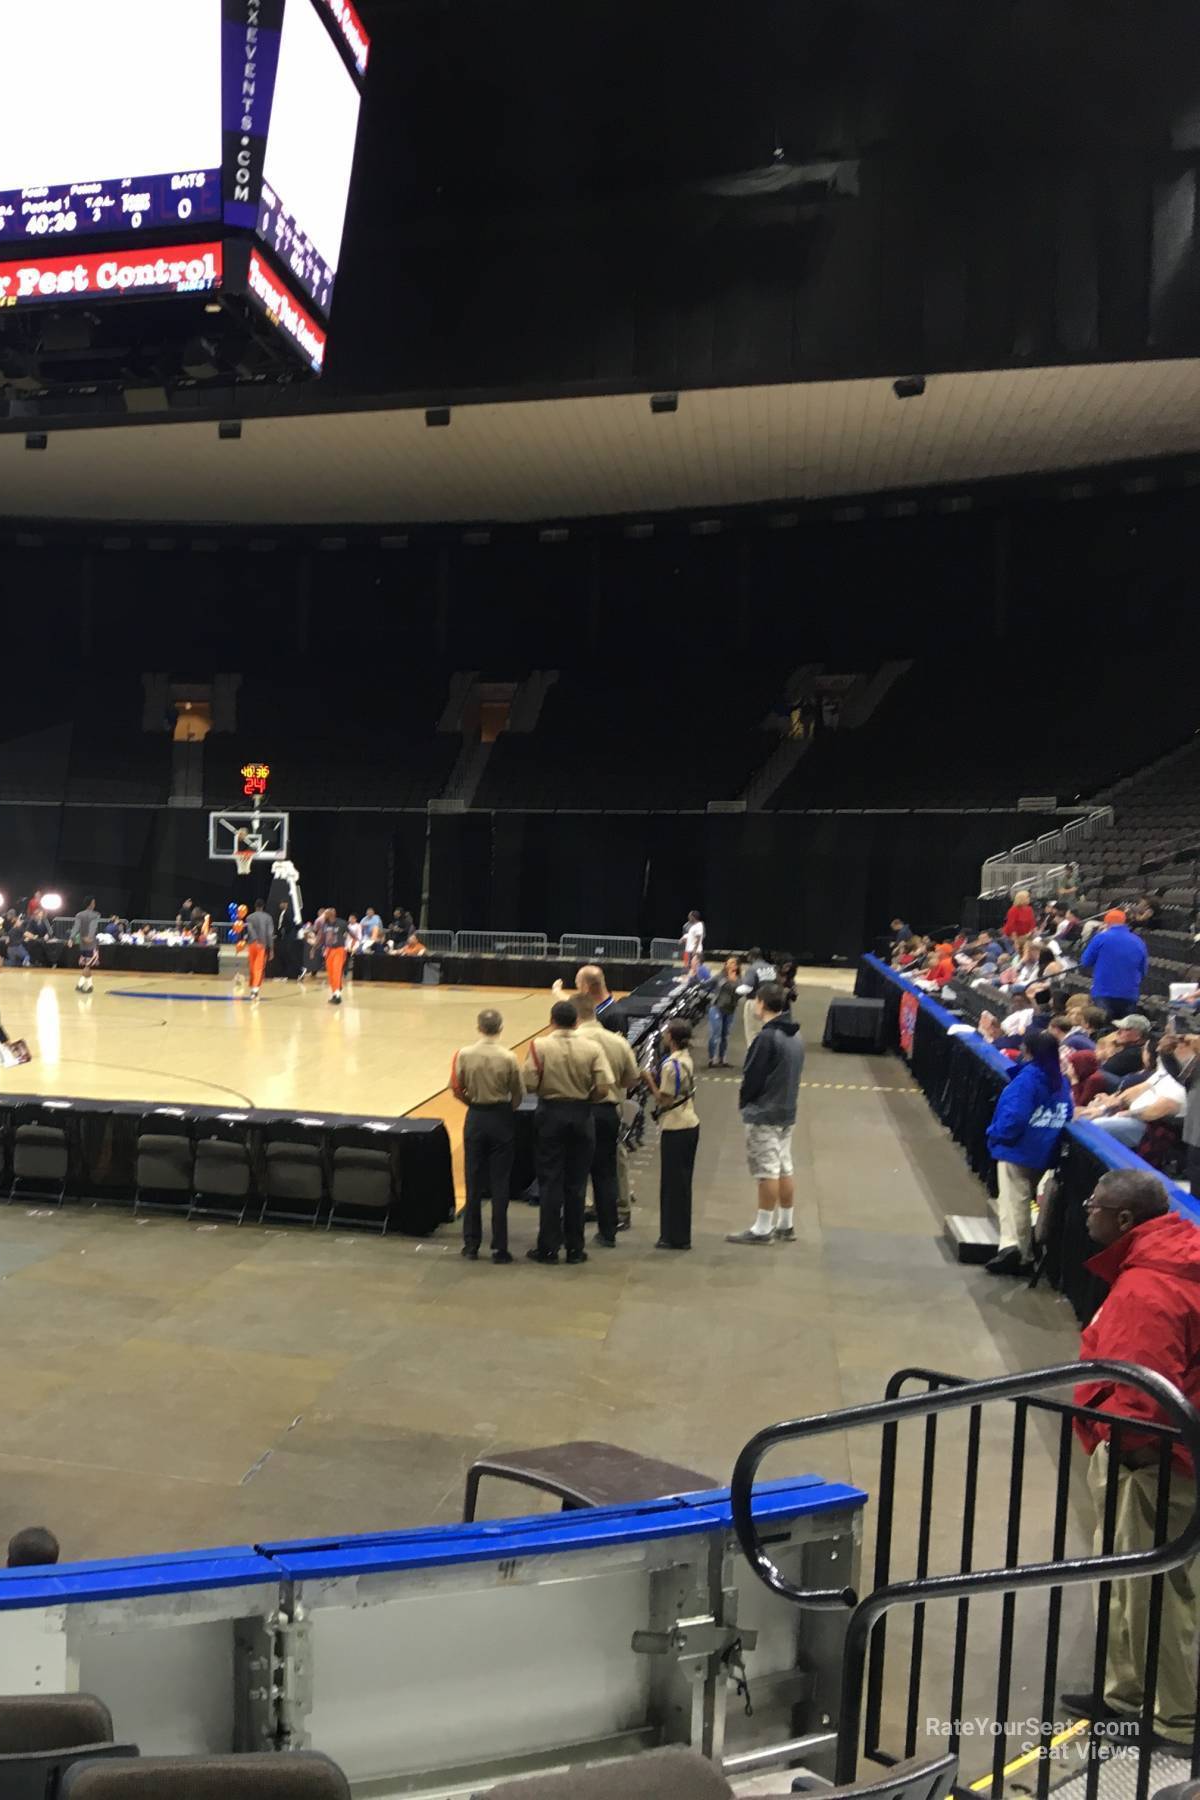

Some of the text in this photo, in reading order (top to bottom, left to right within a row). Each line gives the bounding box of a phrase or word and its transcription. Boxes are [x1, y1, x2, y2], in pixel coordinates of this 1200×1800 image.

[177, 198, 192, 219] 0
[16, 265, 89, 297] Pest
[96, 254, 217, 289] Control
